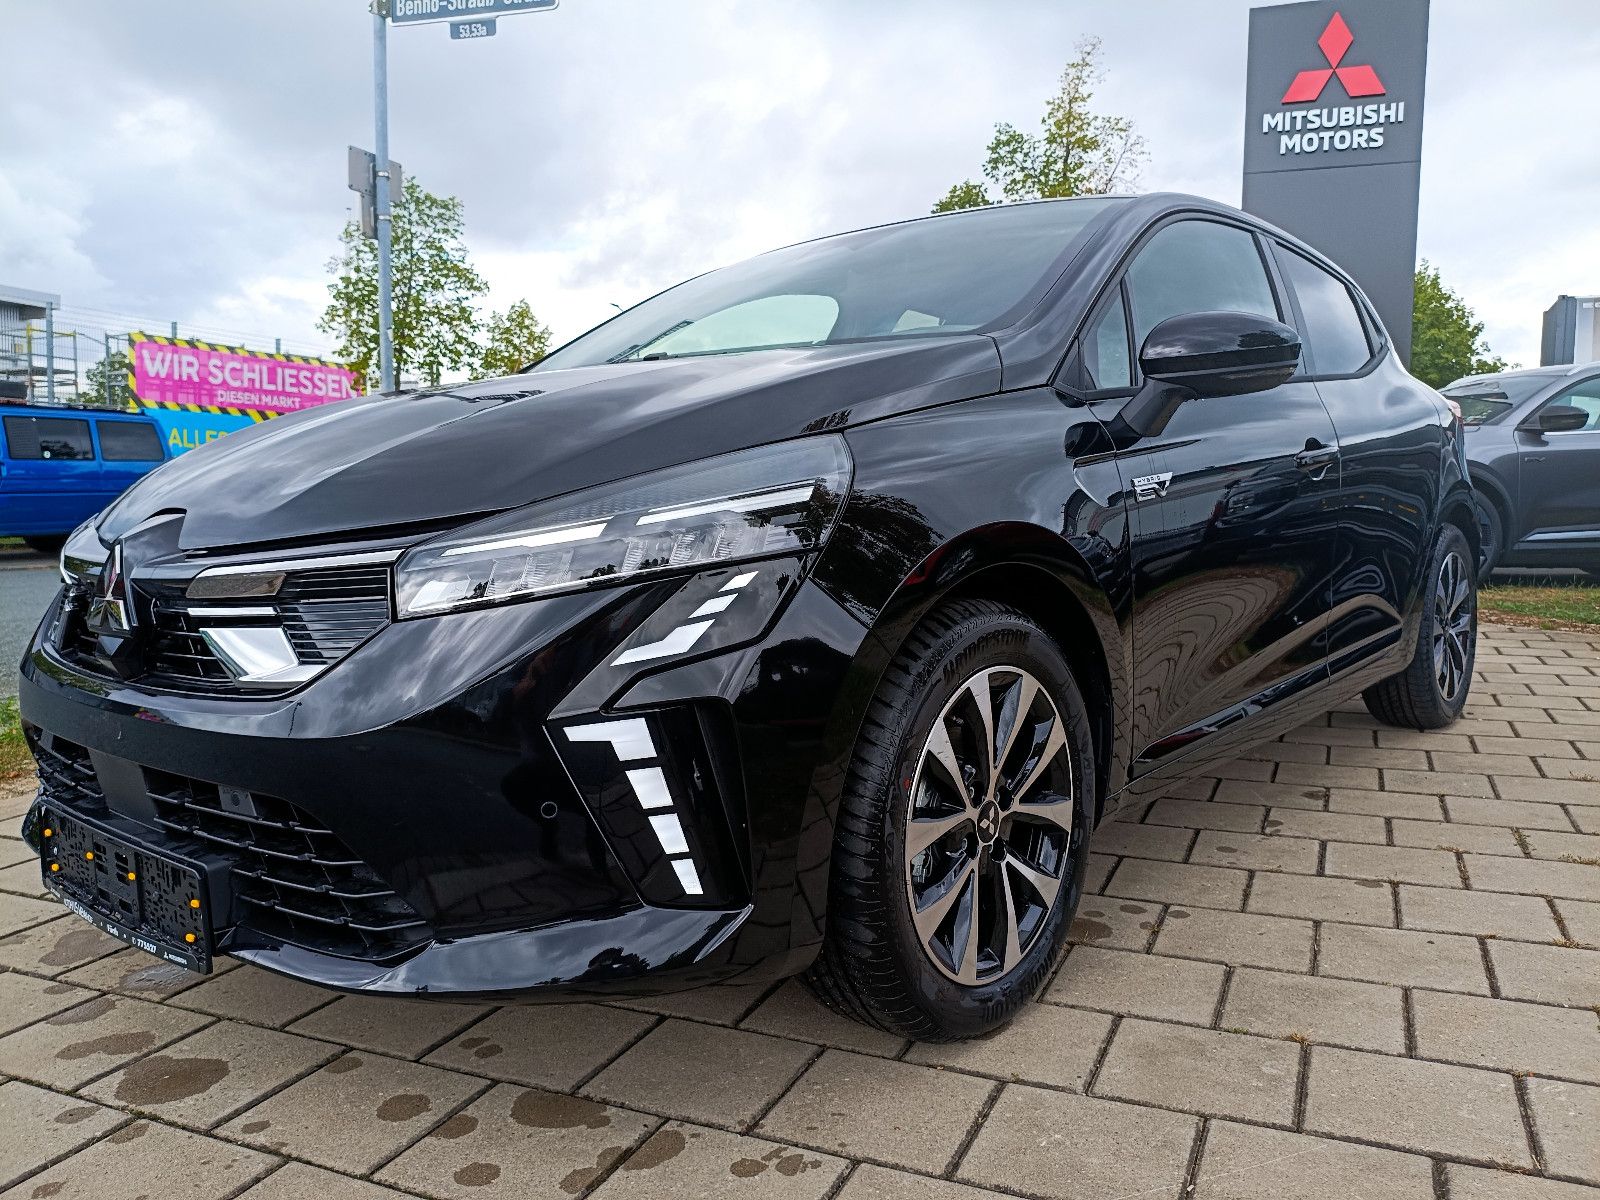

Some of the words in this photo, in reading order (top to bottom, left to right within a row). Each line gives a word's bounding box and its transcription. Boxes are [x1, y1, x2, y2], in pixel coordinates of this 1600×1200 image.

[1262, 101, 1405, 133] MITSUBISHI
[1279, 127, 1385, 155] MOTORS
[141, 349, 200, 382] WIR
[208, 359, 354, 399] SCHLIESSEN
[217, 389, 261, 406] DIESEN
[262, 393, 300, 409] MARKT
